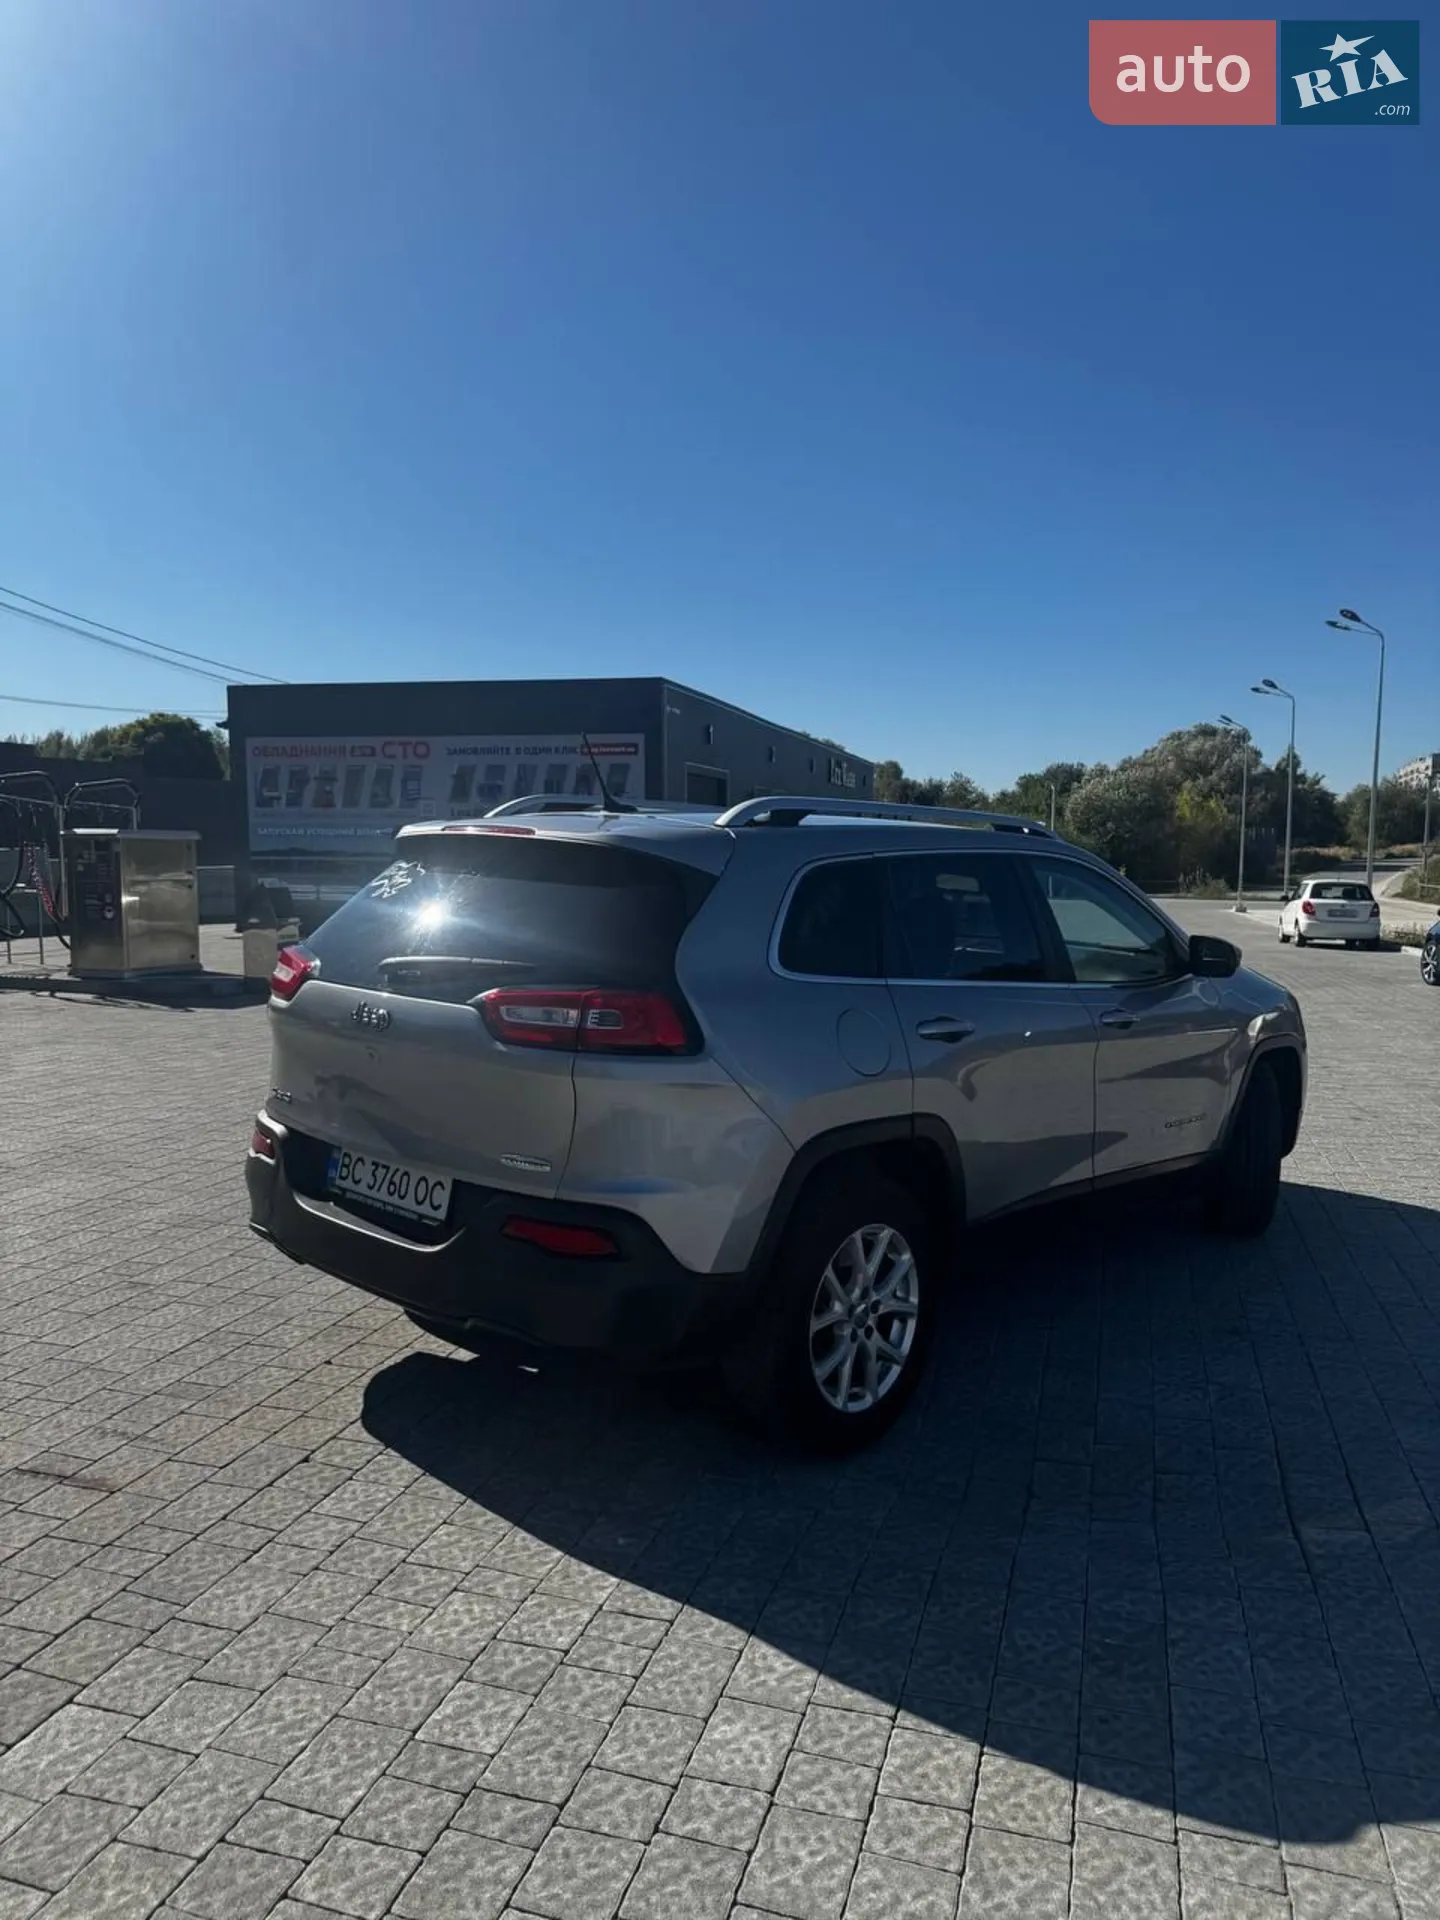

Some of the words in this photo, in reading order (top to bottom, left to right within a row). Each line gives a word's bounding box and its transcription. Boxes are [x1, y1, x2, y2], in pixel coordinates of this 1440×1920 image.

[381, 740, 431, 760] СТО
[350, 1001, 392, 1032] Jeep
[338, 1151, 366, 1186] BC
[367, 1161, 411, 1201] 3760
[414, 1175, 446, 1212] OC
